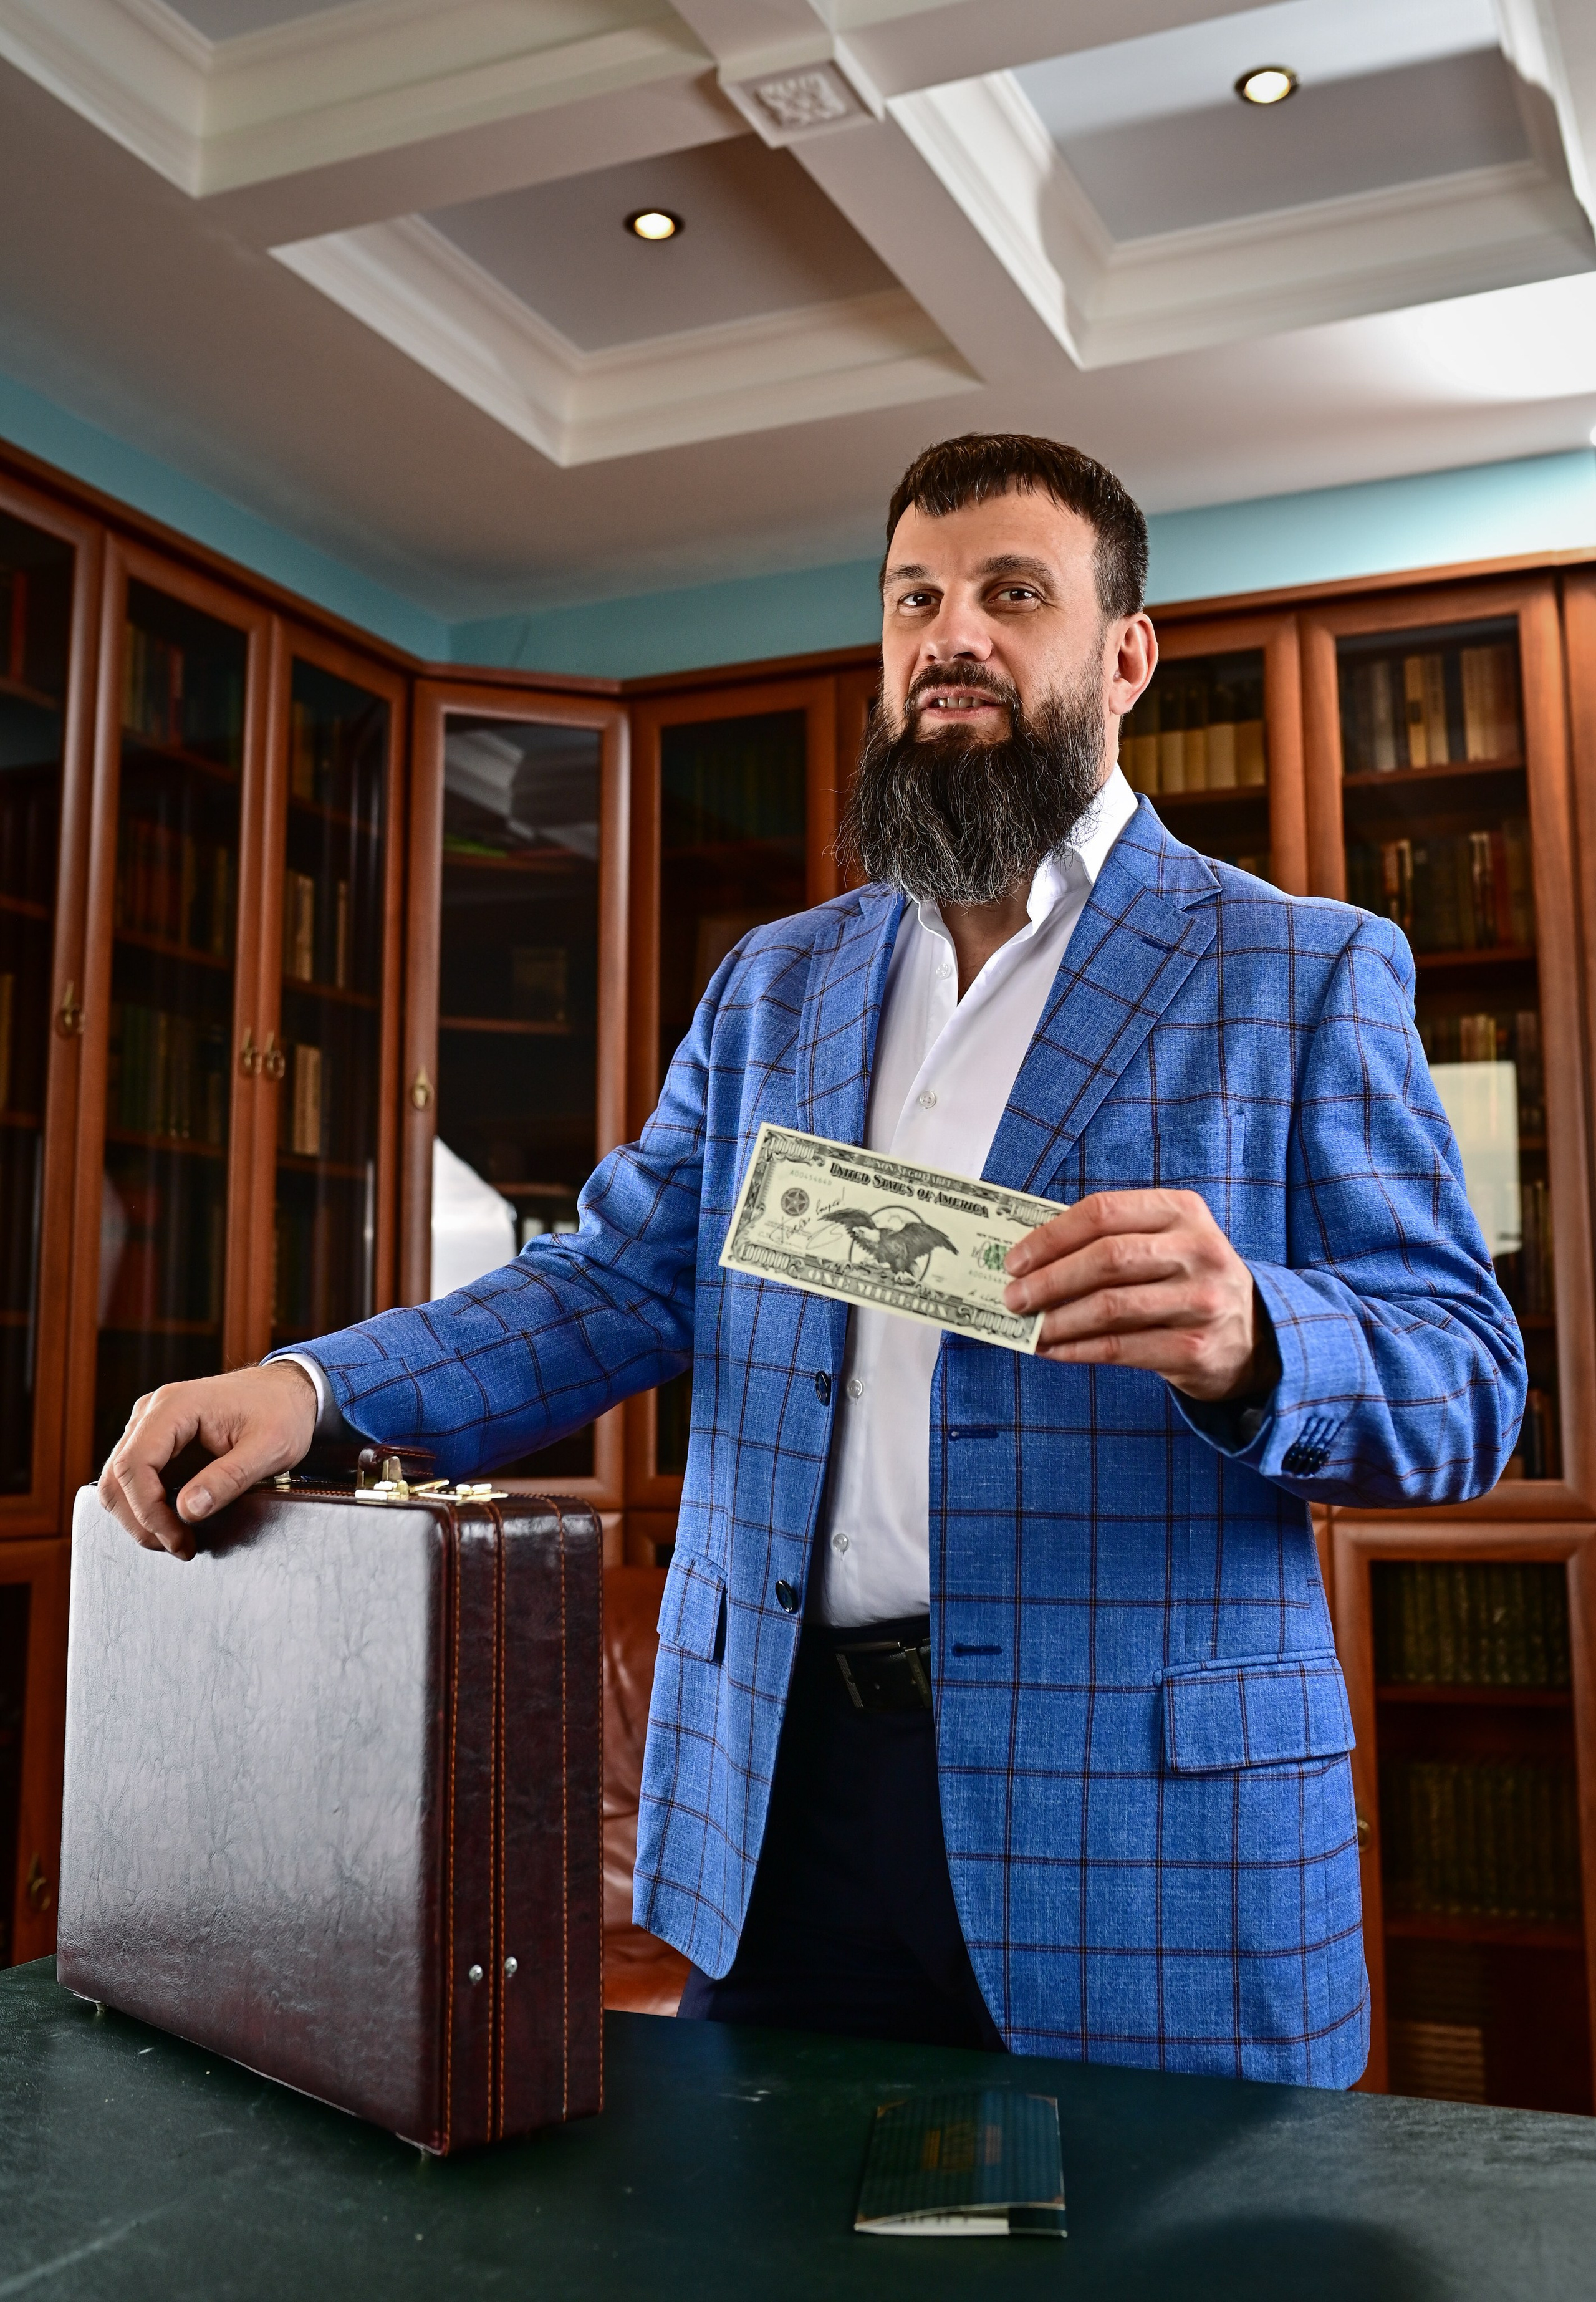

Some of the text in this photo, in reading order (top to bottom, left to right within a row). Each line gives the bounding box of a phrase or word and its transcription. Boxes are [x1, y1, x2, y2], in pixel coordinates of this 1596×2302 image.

[830, 1162, 989, 1218] UNITED STATES OF AMERICA
[808, 1269, 851, 1289] ONE
[857, 1282, 947, 1317] MILLION
